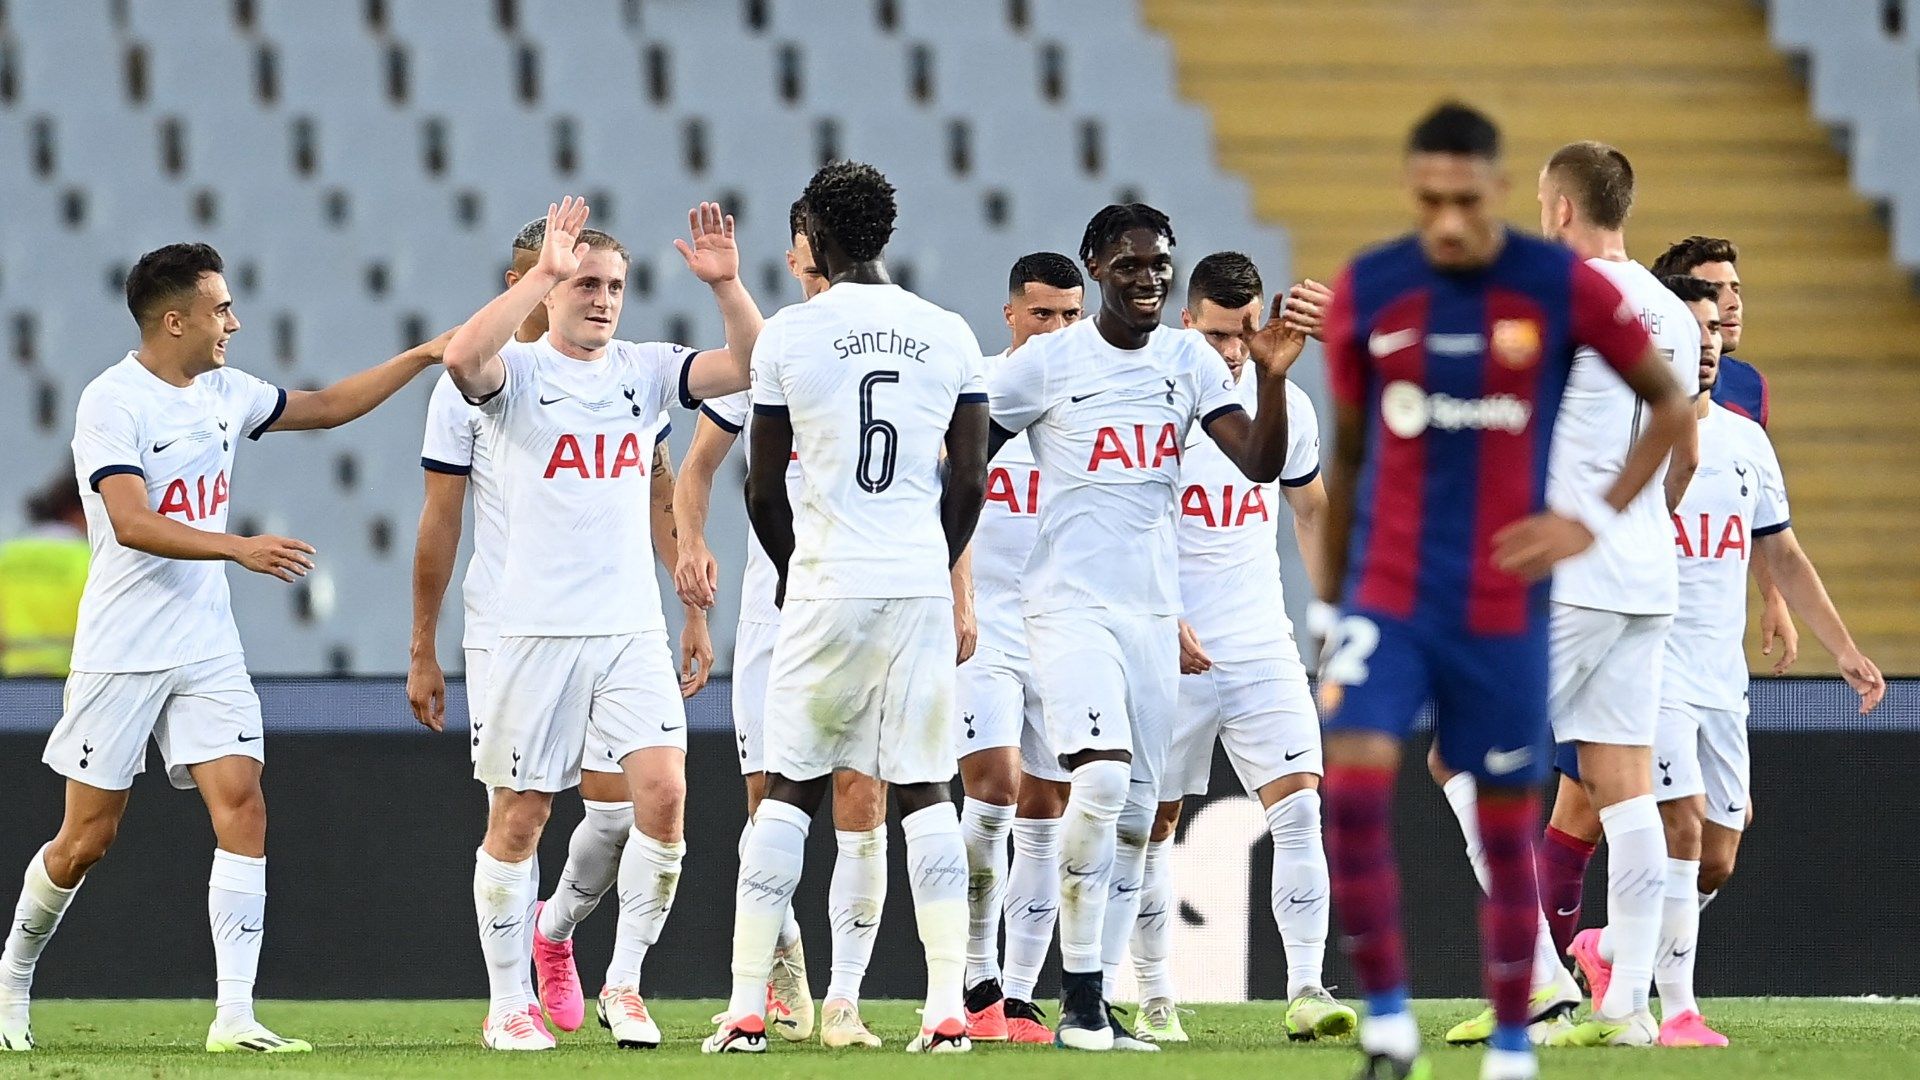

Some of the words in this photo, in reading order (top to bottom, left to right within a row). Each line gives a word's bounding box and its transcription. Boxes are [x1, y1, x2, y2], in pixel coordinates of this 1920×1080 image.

[543, 432, 645, 479] AIA
[855, 370, 900, 494] 6
[1087, 422, 1181, 472] AIA
[157, 469, 228, 522] AIA
[984, 467, 1040, 514] AI
[1181, 485, 1268, 527] AIA
